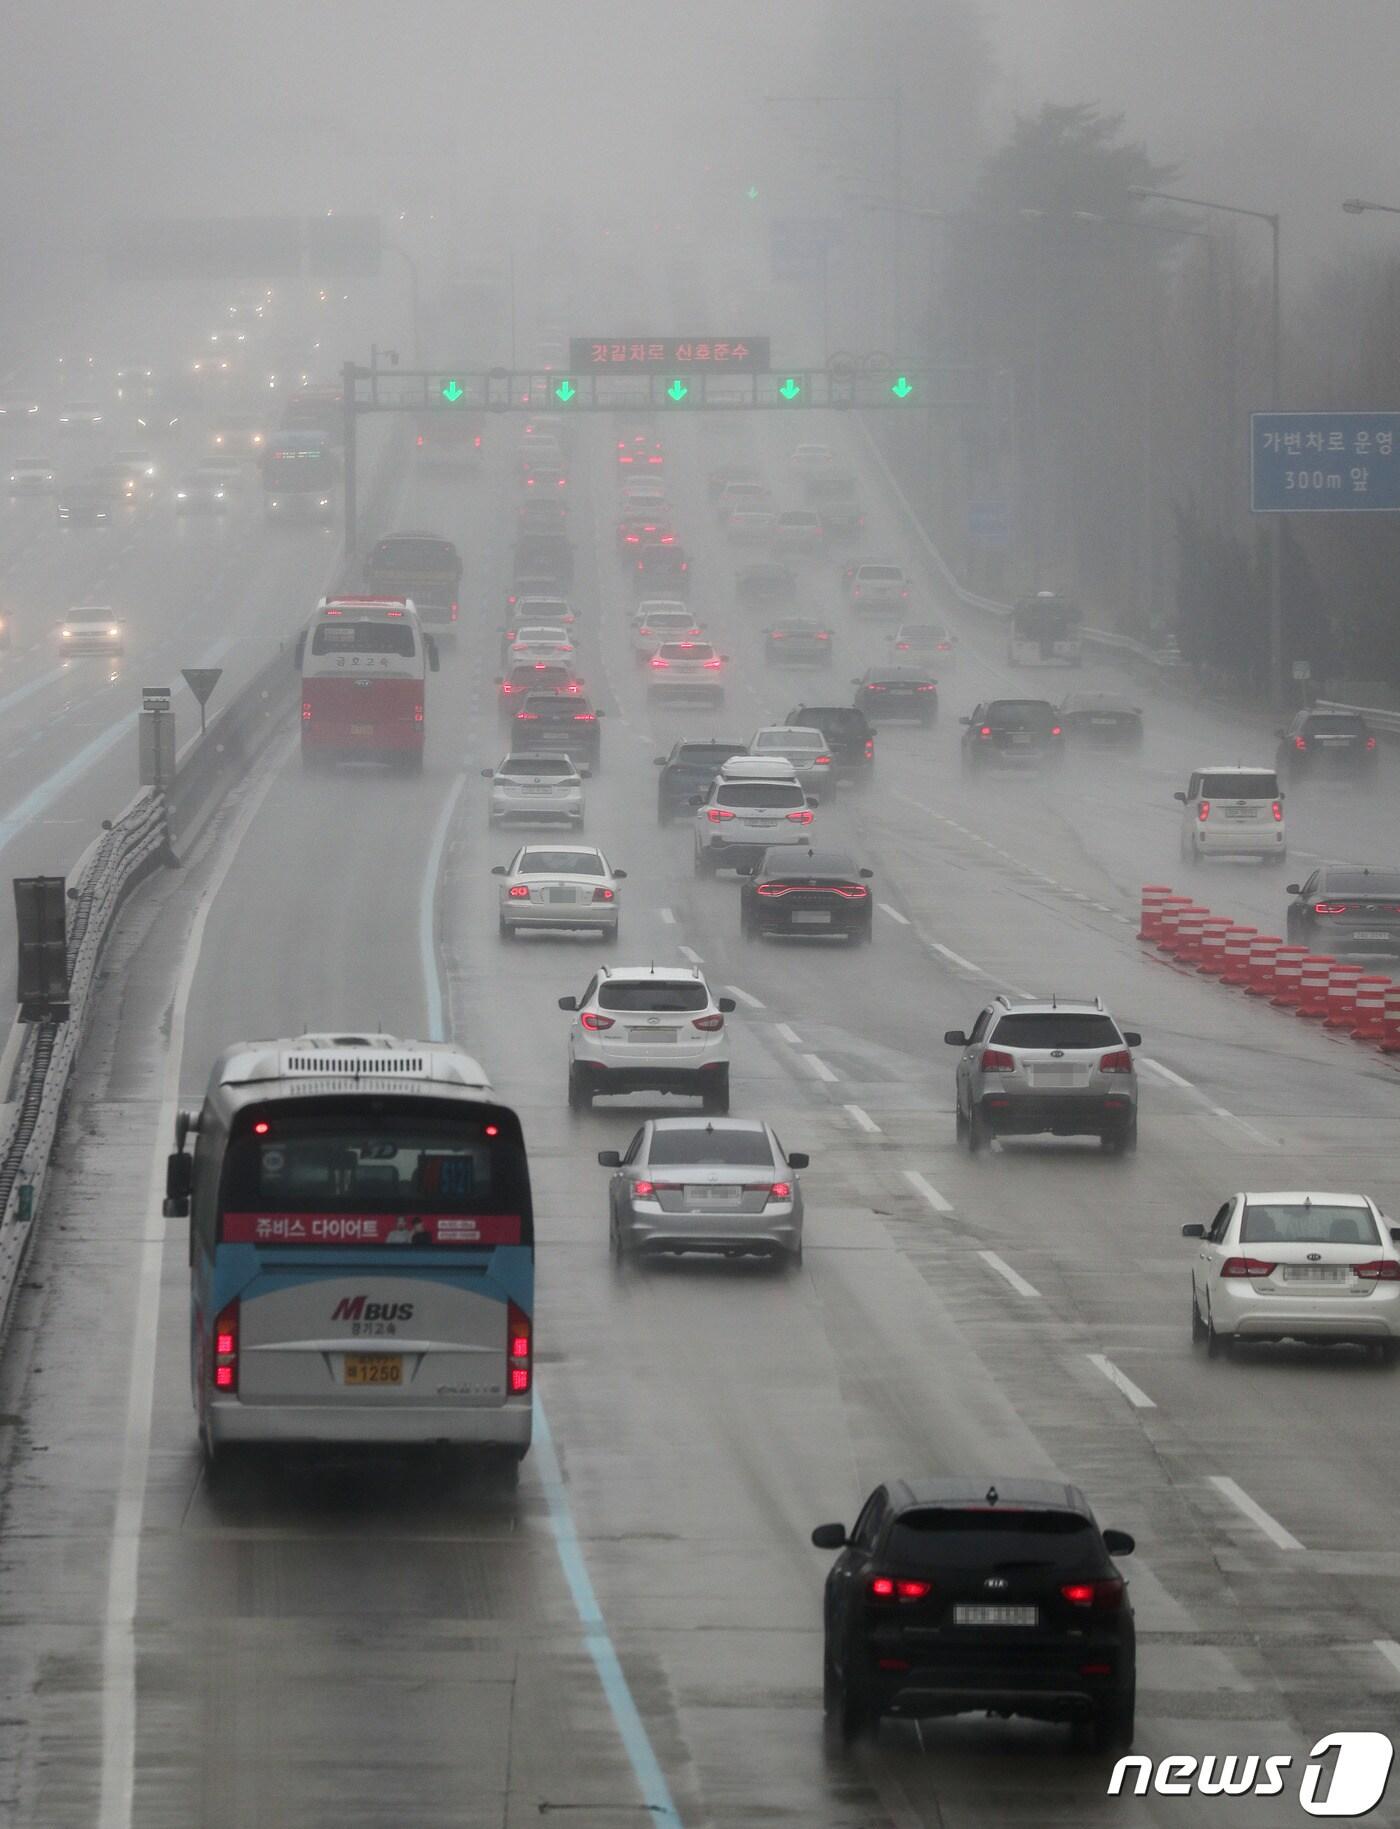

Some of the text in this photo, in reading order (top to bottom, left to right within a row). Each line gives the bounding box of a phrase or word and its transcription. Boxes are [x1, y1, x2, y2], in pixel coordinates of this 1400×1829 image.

[591, 343, 749, 362] 갓길차로 신호준수
[1263, 431, 1393, 455] 가변차로 운영
[1285, 467, 1369, 491] 300m 앞
[312, 1218, 379, 1239] 다이어트
